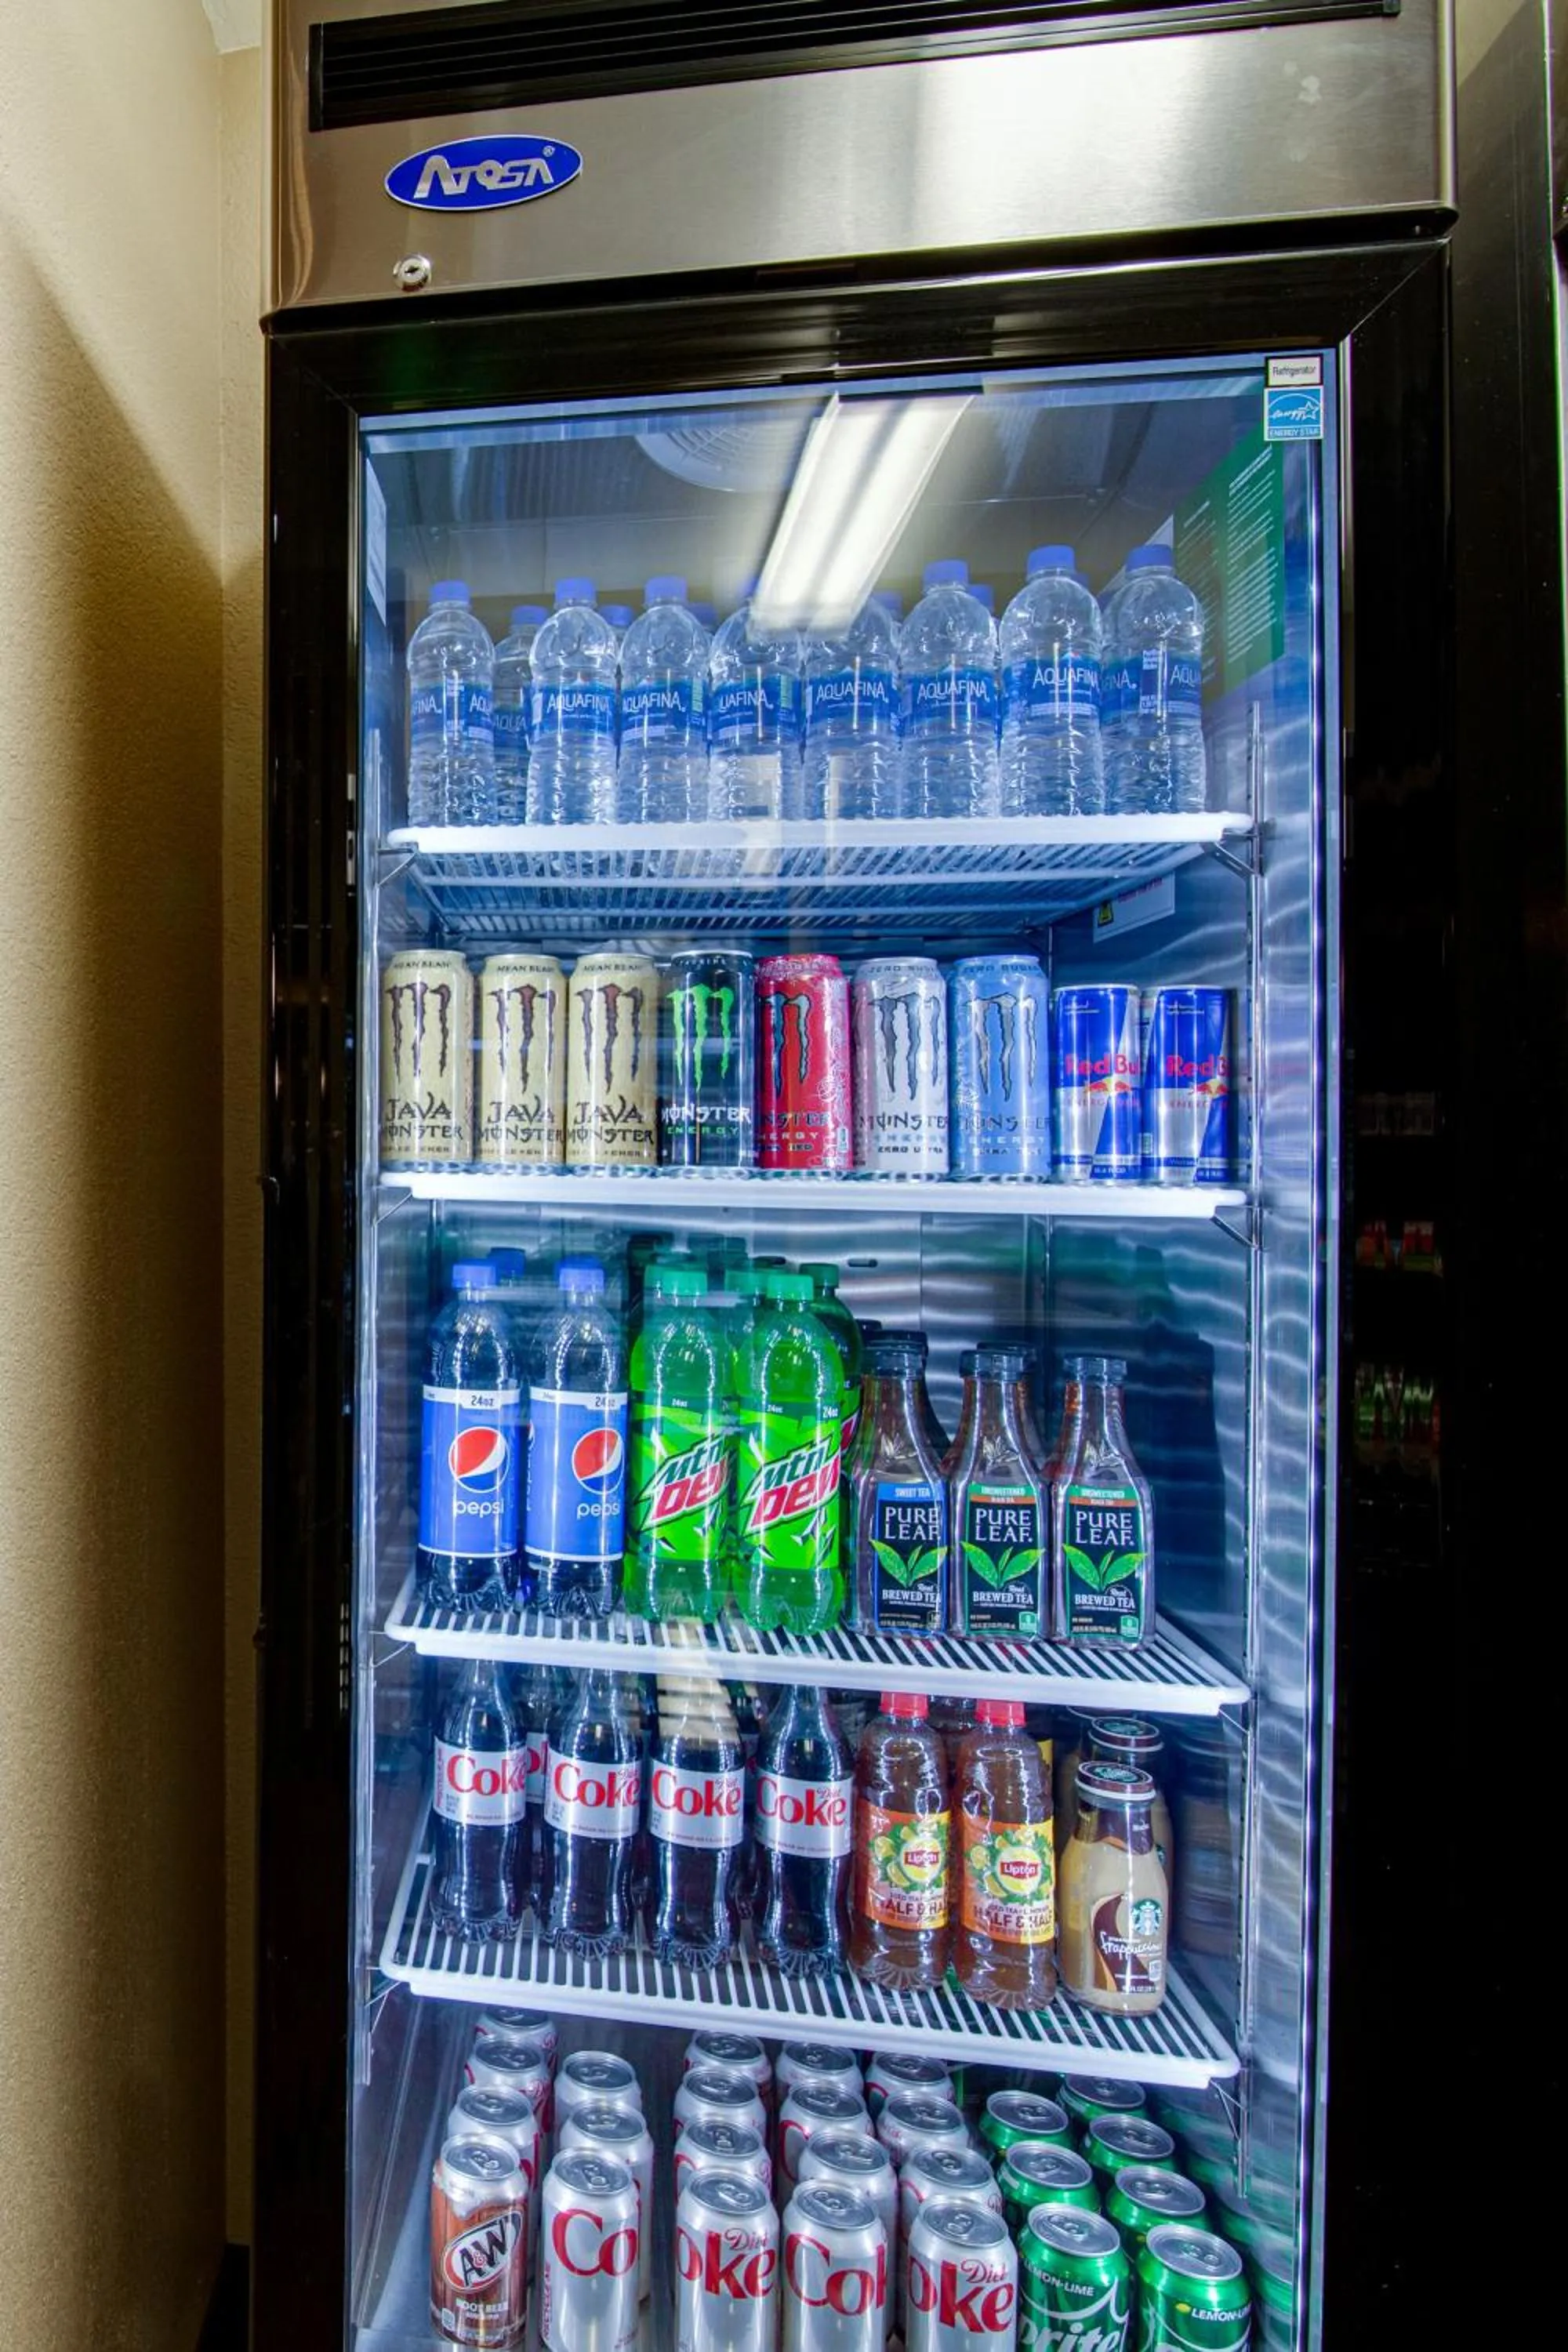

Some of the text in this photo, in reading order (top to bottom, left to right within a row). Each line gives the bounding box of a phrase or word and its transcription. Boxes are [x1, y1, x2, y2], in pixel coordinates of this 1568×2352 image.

[1167, 1054, 1214, 1076] Red
[385, 1091, 452, 1122] JAVA
[487, 1094, 555, 1123] JAVA
[573, 1094, 644, 1125] JAVA
[661, 1102, 753, 1124] MONSTER
[477, 1124, 564, 1144] MONSTER
[567, 1126, 654, 1145] MONSTER
[453, 1498, 504, 1519] pepsi
[885, 1506, 938, 1523] PURE
[975, 1508, 1032, 1526] PURE
[1075, 1510, 1133, 1529] PURE
[884, 1523, 939, 1541] LEAF
[882, 1589, 923, 1601] BREWED
[972, 1591, 1034, 1605] BREWED TEA
[1075, 1594, 1136, 1609] BREWED TEA
[554, 1762, 641, 1809] Coke
[652, 1769, 742, 1817] Coke
[757, 1775, 848, 1827] Coke
[907, 1851, 938, 1865] Lipton
[1004, 1864, 1036, 1878] Lipton
[724, 2227, 769, 2250] Diet
[459, 2216, 508, 2288] A&W
[961, 2259, 1008, 2284] Diet
[1024, 2259, 1095, 2297] LEMON-LIME
